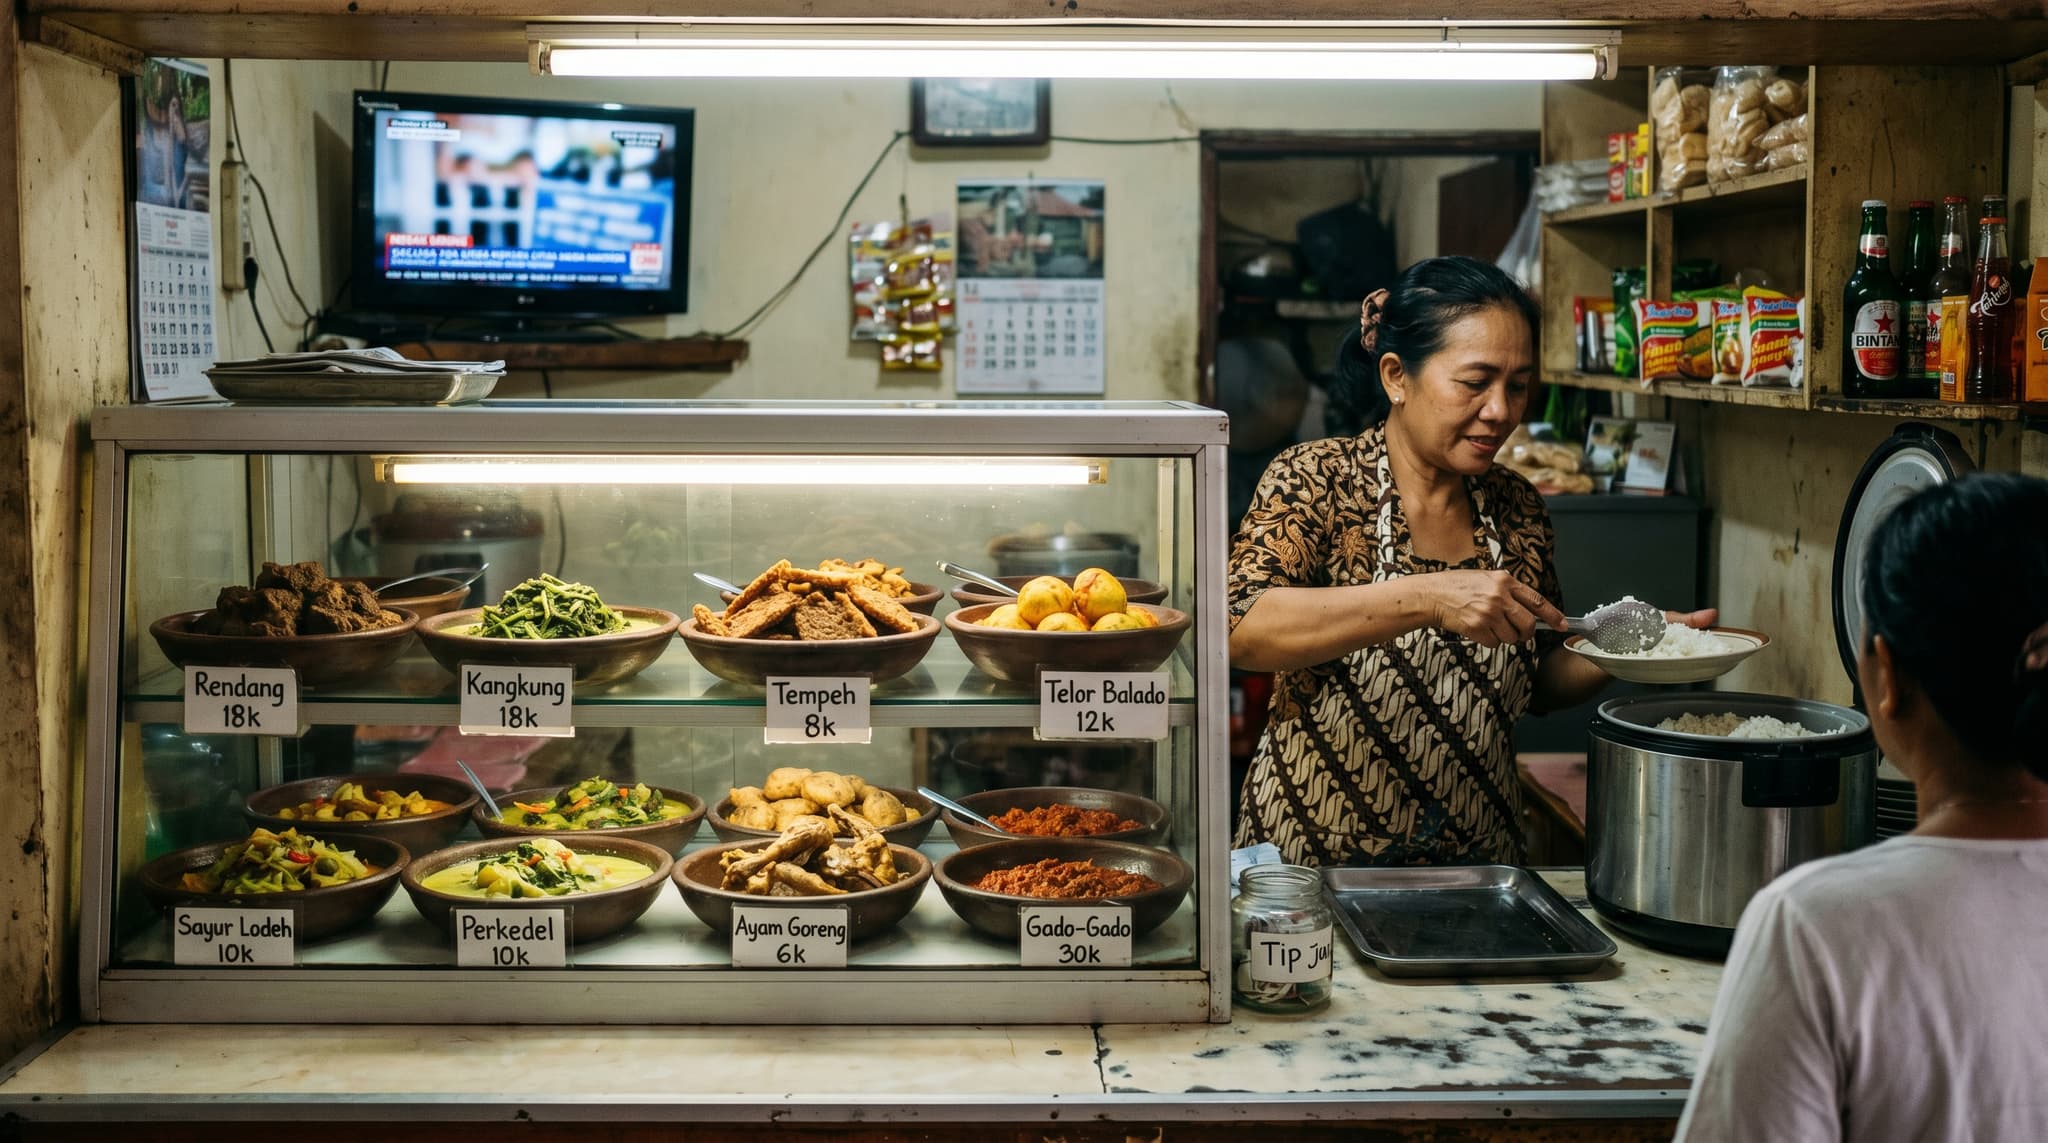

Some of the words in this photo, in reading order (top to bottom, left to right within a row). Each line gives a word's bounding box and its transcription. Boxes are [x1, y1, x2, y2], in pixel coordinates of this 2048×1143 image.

[178, 263, 182, 276] 2
[202, 265, 206, 277] 4
[195, 671, 284, 707] Rendang
[467, 671, 565, 705] Kangkung
[772, 682, 856, 712] Tempeh
[1044, 679, 1097, 704] Telor
[1103, 680, 1166, 705] Balado
[224, 704, 261, 729] 18k
[500, 705, 538, 729] 18k
[804, 713, 836, 738] 8k
[1076, 710, 1115, 733] 12k
[178, 914, 234, 943] Sayur
[239, 916, 292, 938] Lodeh
[462, 915, 554, 941] Perkedel
[734, 914, 783, 942] Ayam
[788, 916, 846, 945] Goreng
[1026, 915, 1131, 938] Gado-Gado
[218, 944, 255, 964] 10k
[492, 945, 530, 966] 10k
[776, 943, 806, 964] 6k
[1058, 943, 1101, 964] 30k
[1260, 941, 1301, 974] Tip
